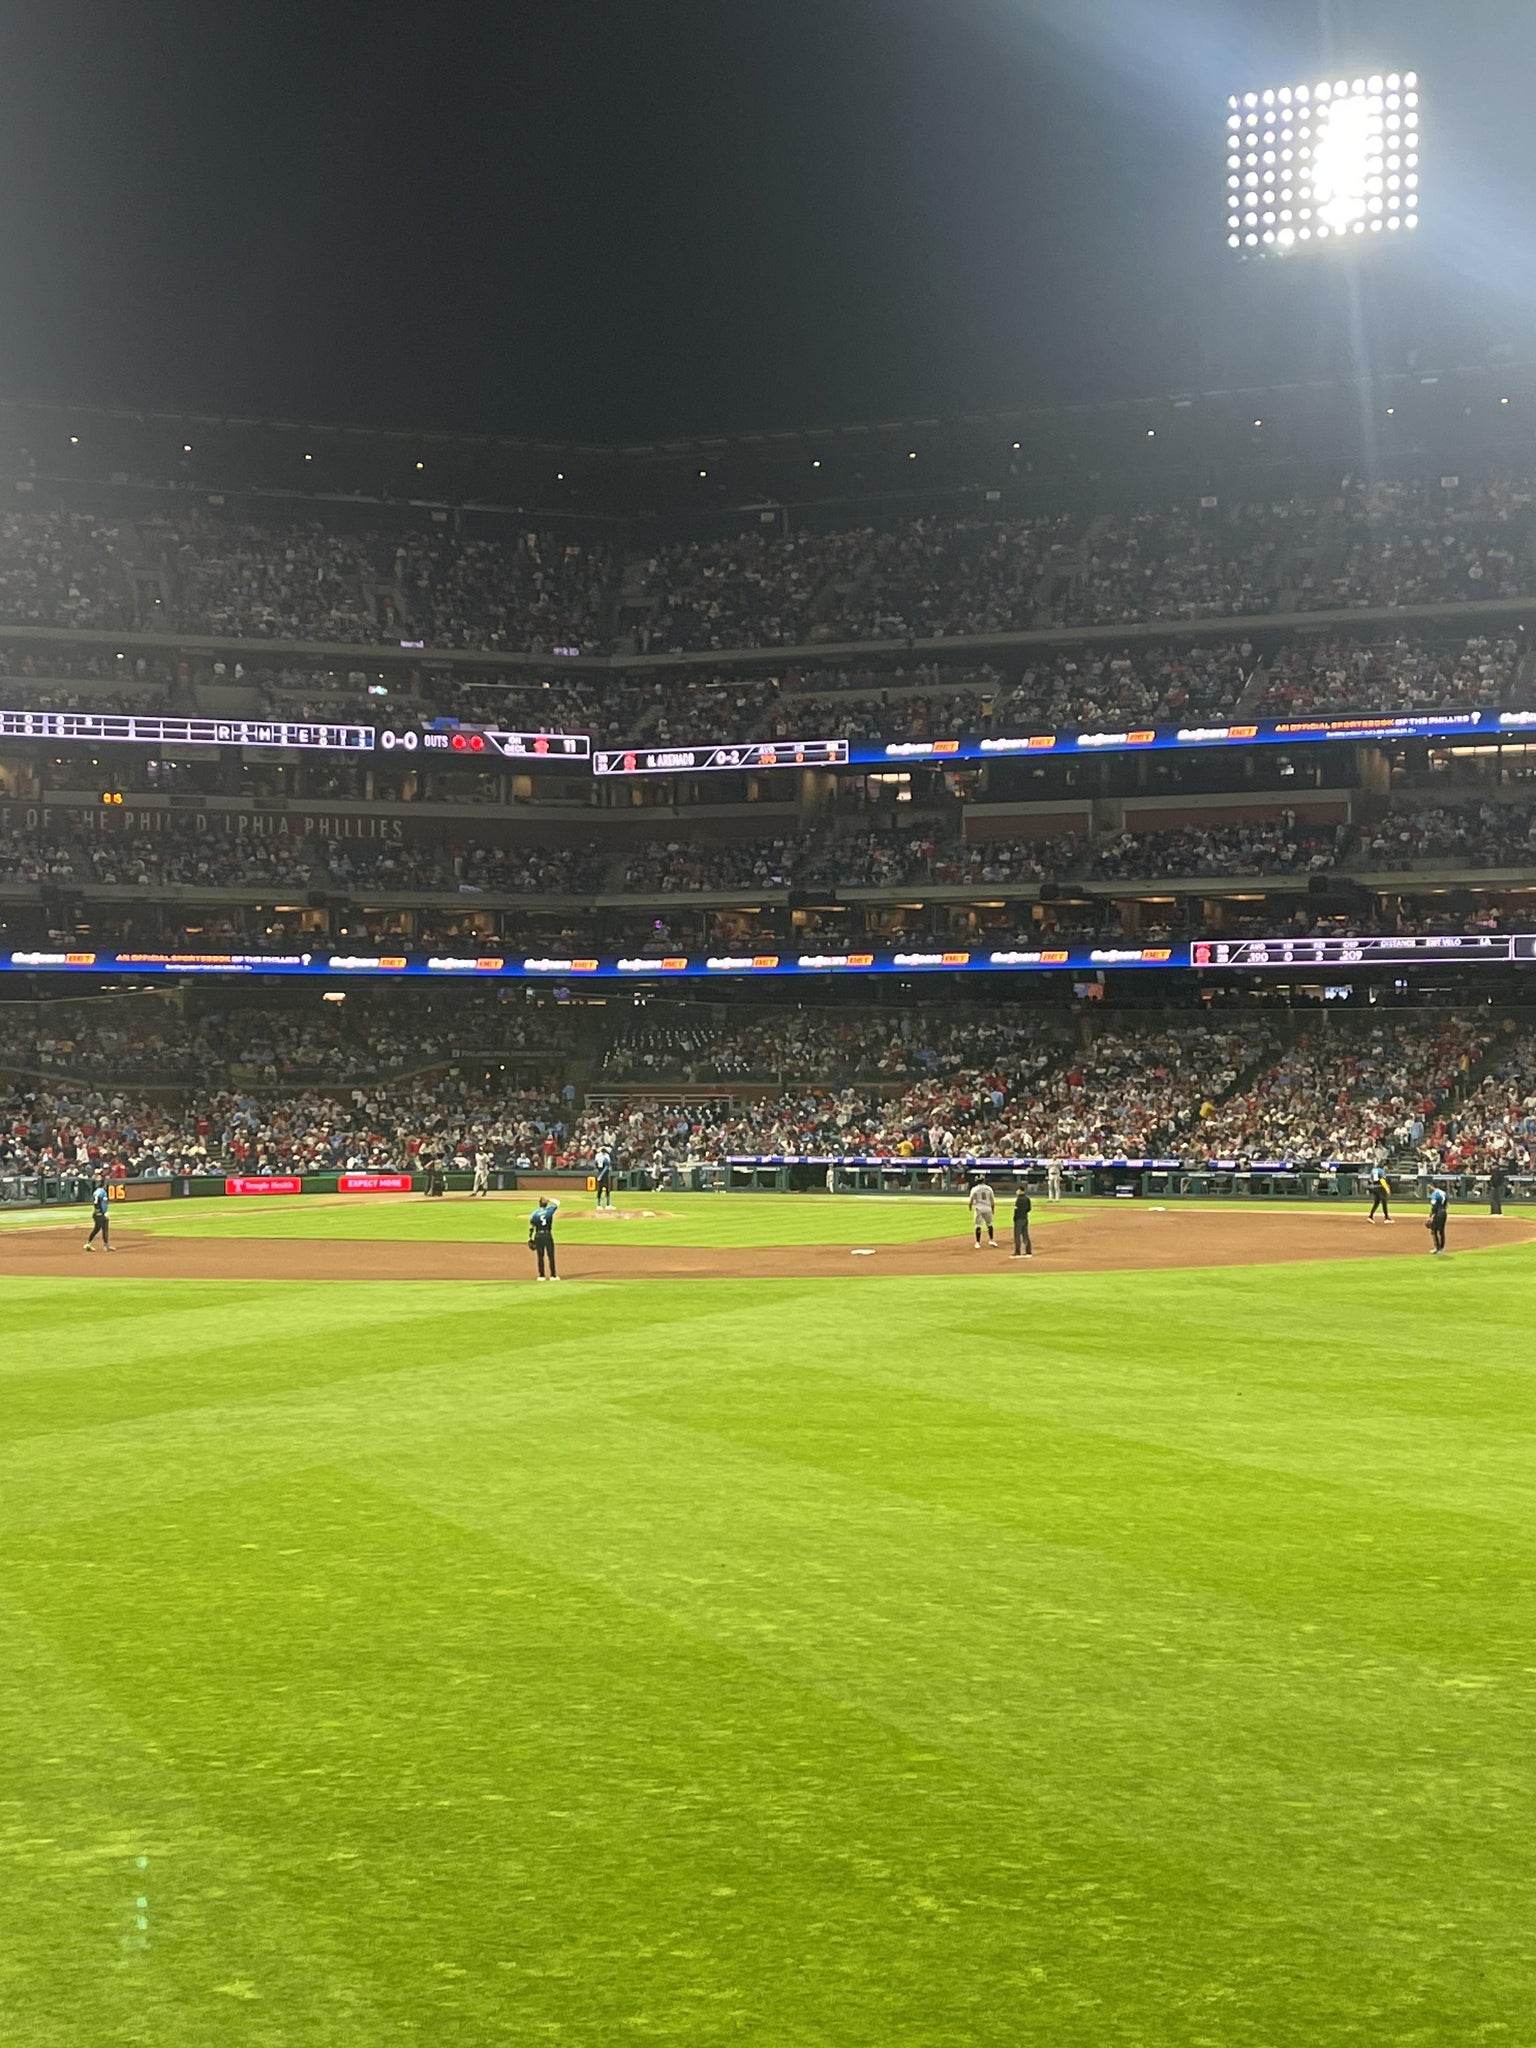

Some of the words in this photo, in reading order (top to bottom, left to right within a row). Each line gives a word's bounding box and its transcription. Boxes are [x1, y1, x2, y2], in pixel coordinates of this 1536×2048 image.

[218, 726, 230, 740] R
[299, 729, 309, 742] E
[381, 730, 418, 749] 0-0
[424, 734, 448, 748] OUTS
[563, 739, 576, 753] 11
[657, 752, 695, 766] ARENADO
[716, 750, 740, 764] 0-2
[829, 751, 836, 761] 2
[305, 817, 402, 838] PHILLIES
[1284, 951, 1293, 961] 0
[1316, 951, 1323, 961] 2
[347, 1179, 377, 1188] EXPECT
[379, 1179, 402, 1187] MORE
